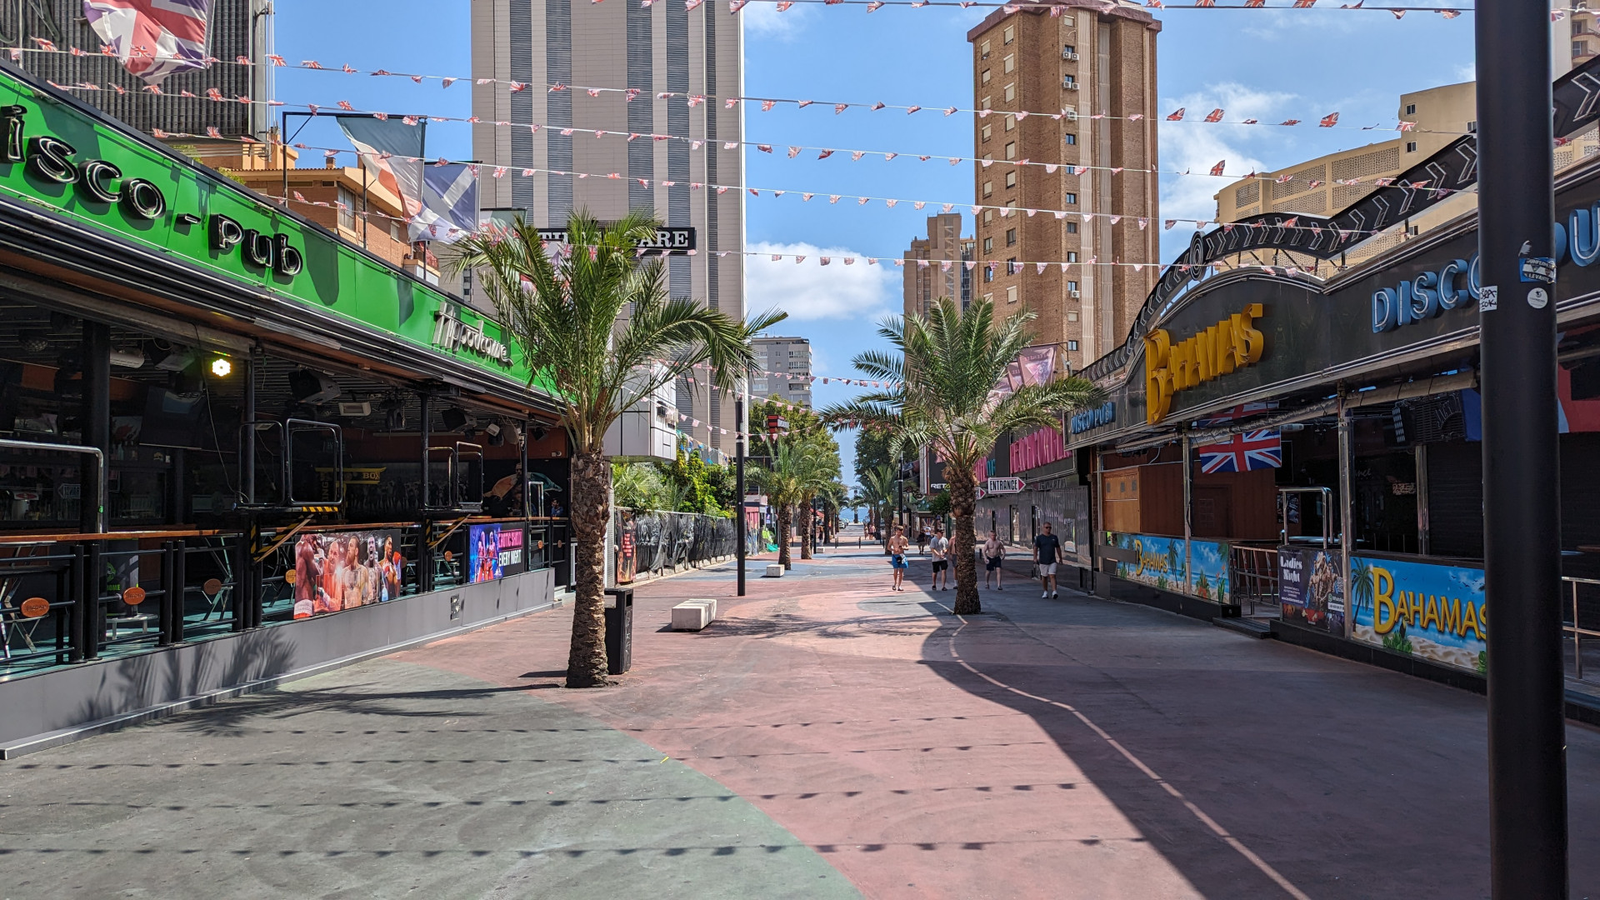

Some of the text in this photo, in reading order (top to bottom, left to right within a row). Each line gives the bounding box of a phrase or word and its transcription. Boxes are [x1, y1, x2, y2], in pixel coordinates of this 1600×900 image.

[1143, 303, 1264, 426] BAHAMAS
[989, 480, 1018, 491] ENTRANCE
[1134, 539, 1168, 576] BAHAMAS
[1280, 556, 1302, 570] Ladies
[1283, 568, 1301, 583] Night
